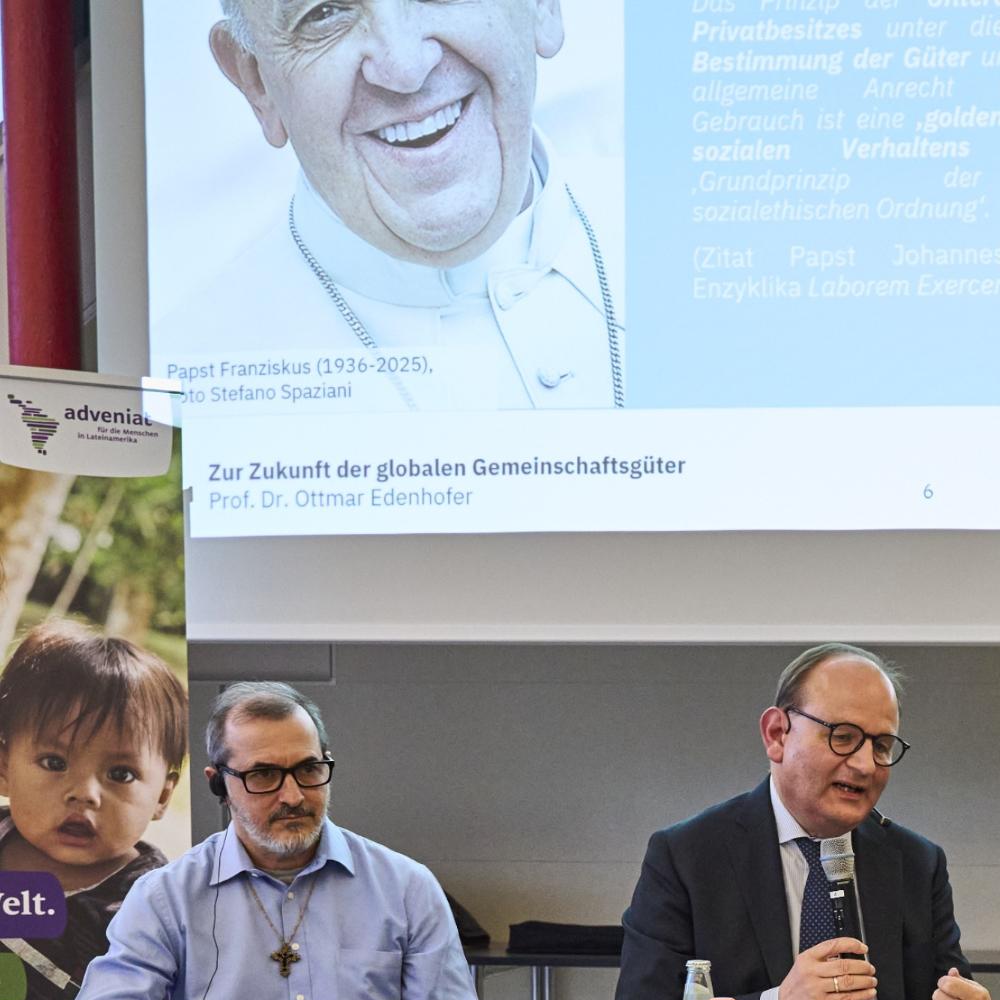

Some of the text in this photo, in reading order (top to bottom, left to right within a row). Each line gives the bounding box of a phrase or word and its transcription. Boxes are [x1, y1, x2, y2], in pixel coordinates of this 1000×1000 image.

[692, 18, 862, 41] Privatbesitzes
[886, 18, 947, 38] unter
[692, 50, 843, 75] Bestimmung
[853, 48, 893, 69] der
[904, 46, 971, 68] Güter
[692, 80, 818, 107] allgemeine
[864, 76, 954, 98] Anrecht
[693, 109, 804, 132] Gebrauch
[817, 111, 845, 130] ist
[856, 107, 904, 129] eine
[693, 139, 790, 161] sozialen
[843, 136, 970, 159] Verhaltens
[944, 166, 982, 188] der
[693, 199, 869, 222] sozialethischen
[694, 246, 753, 272] (Zitat
[790, 246, 855, 271] Papst
[694, 276, 801, 304] Enzyklika
[808, 275, 910, 297] Laborem
[167, 356, 432, 380] Papst Franziskus (1936-2025),
[178, 384, 351, 403] oto Stefano Spaziani
[64, 405, 152, 426] adveniat
[209, 456, 685, 482] Zur Zukunft der globalen Gemeinschaftsgüter
[210, 487, 472, 509] Prof. Dr. Ottmar Edenhofer
[923, 483, 934, 499] 6
